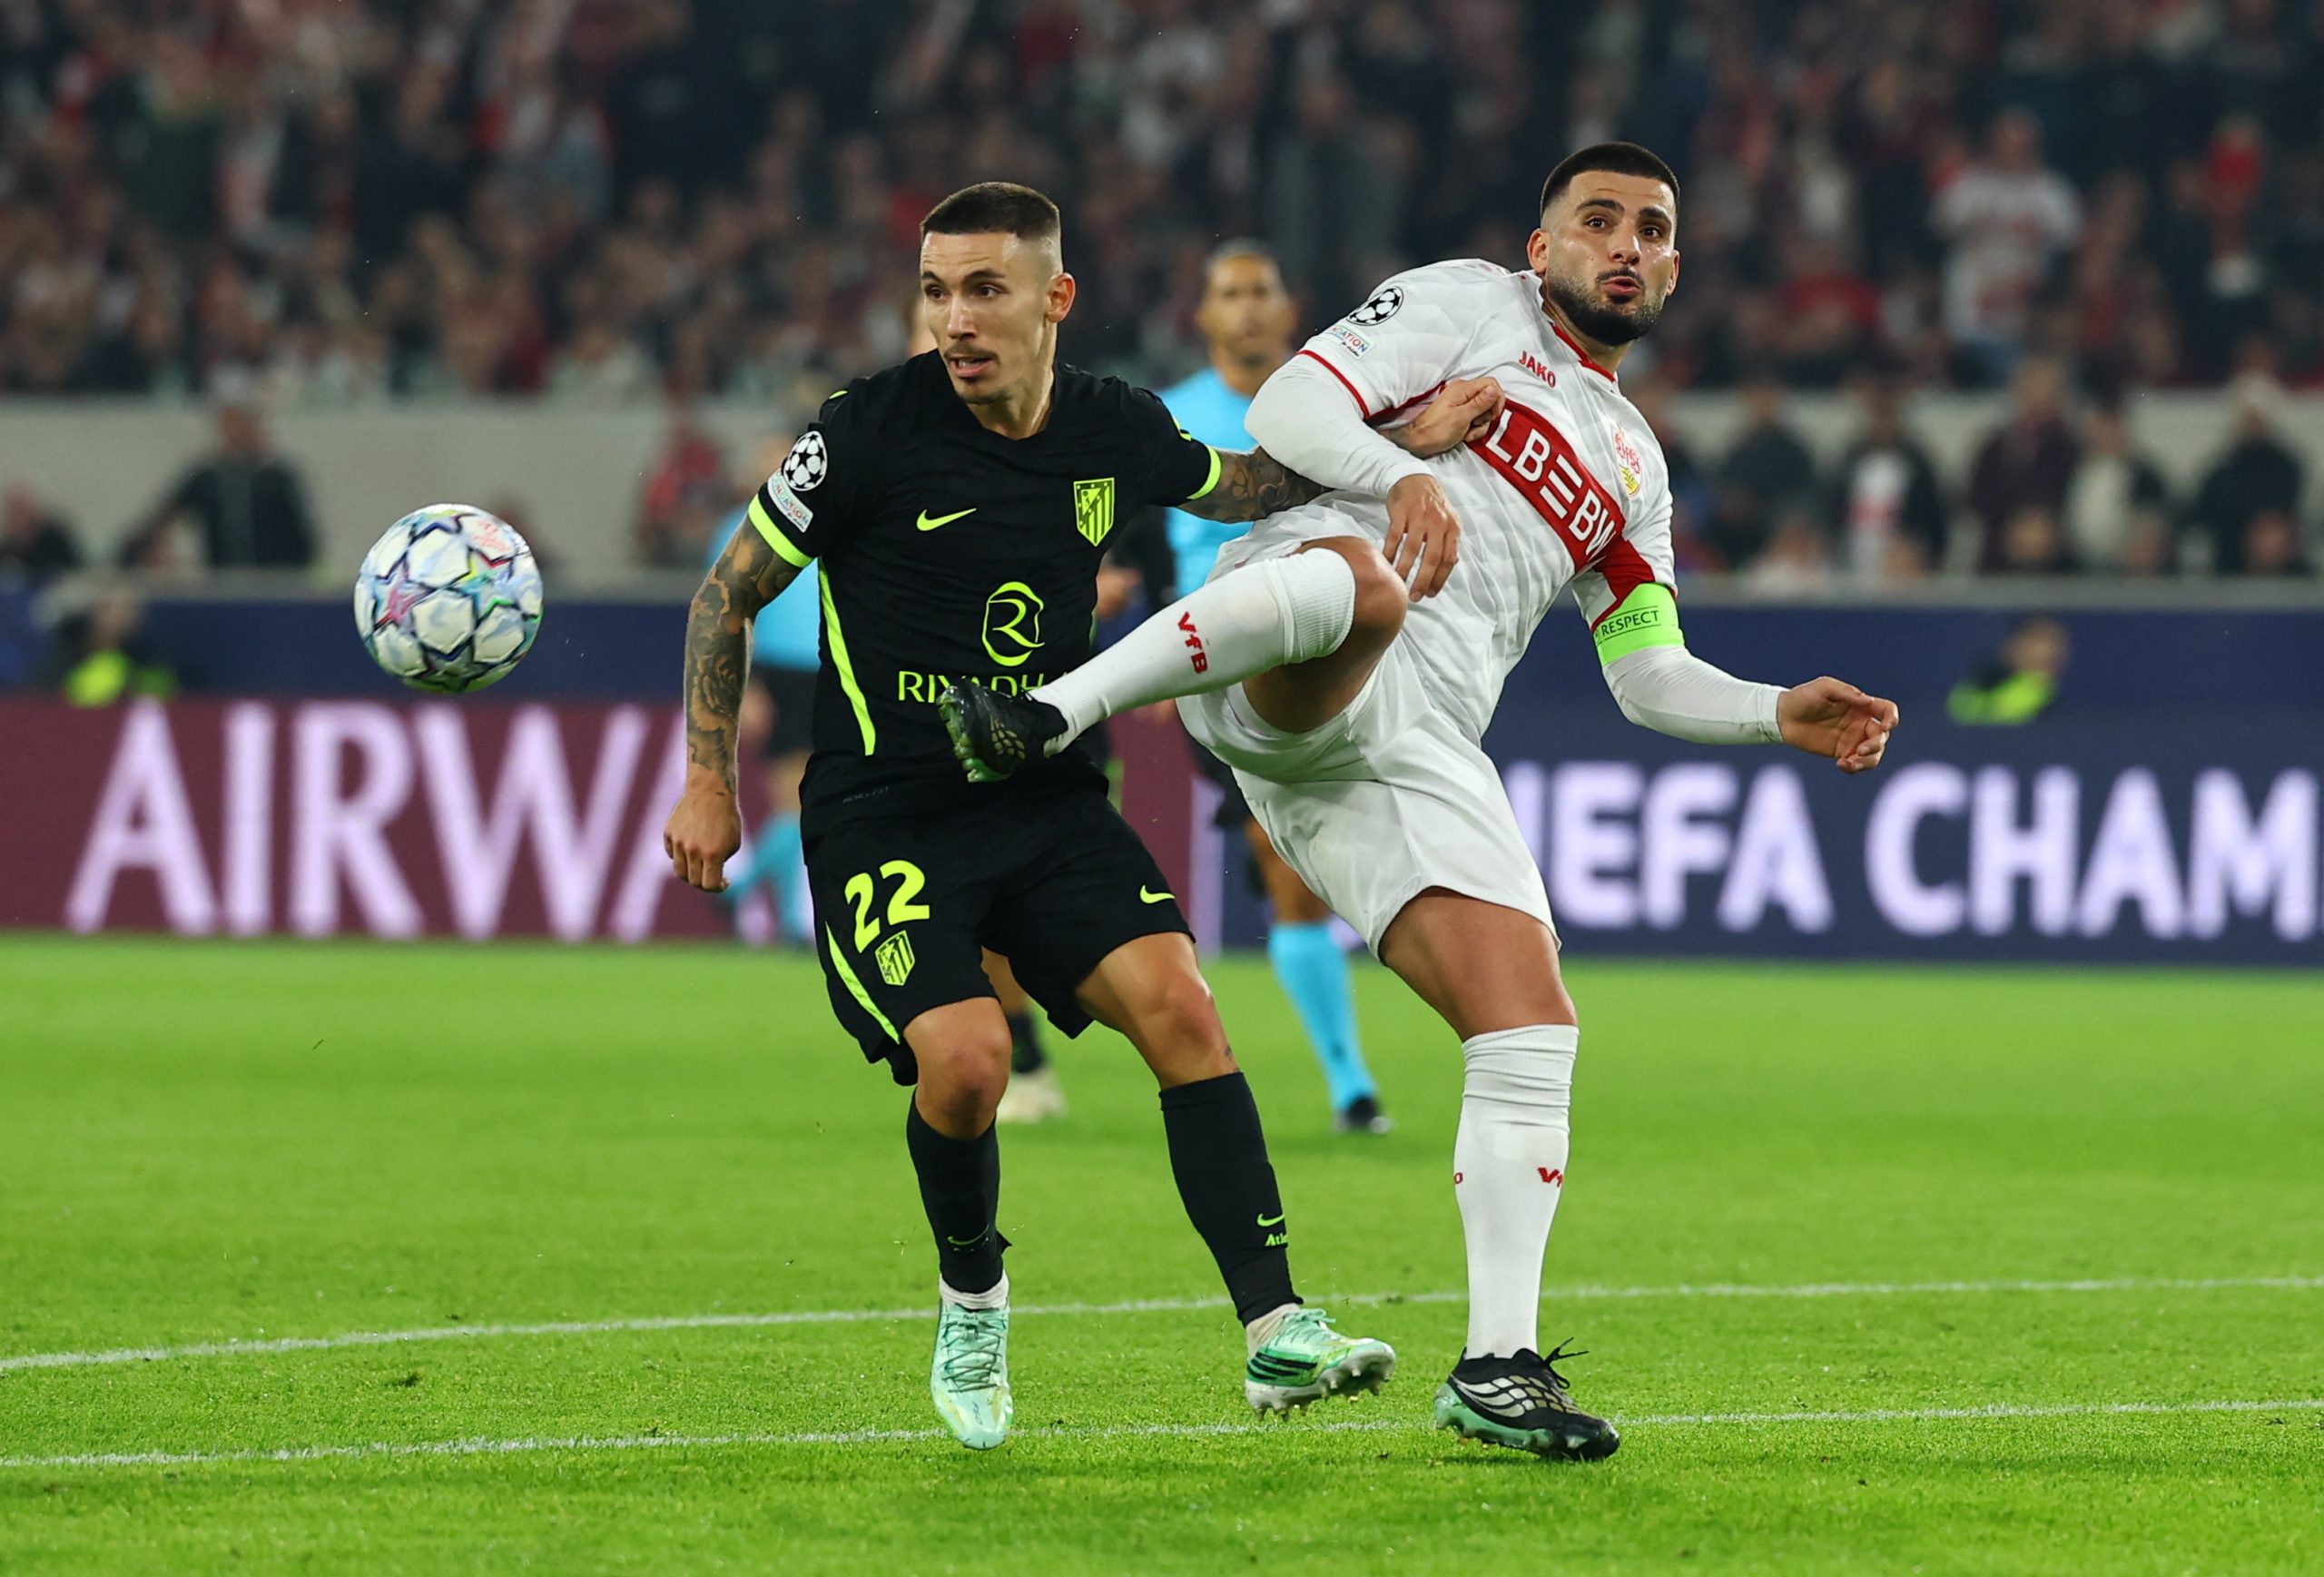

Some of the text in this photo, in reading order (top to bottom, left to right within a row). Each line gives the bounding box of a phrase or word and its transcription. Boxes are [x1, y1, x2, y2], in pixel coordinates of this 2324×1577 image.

[1519, 350, 1556, 389] JAKO
[1600, 610, 1659, 636] RESPECT
[844, 860, 931, 954] 22
